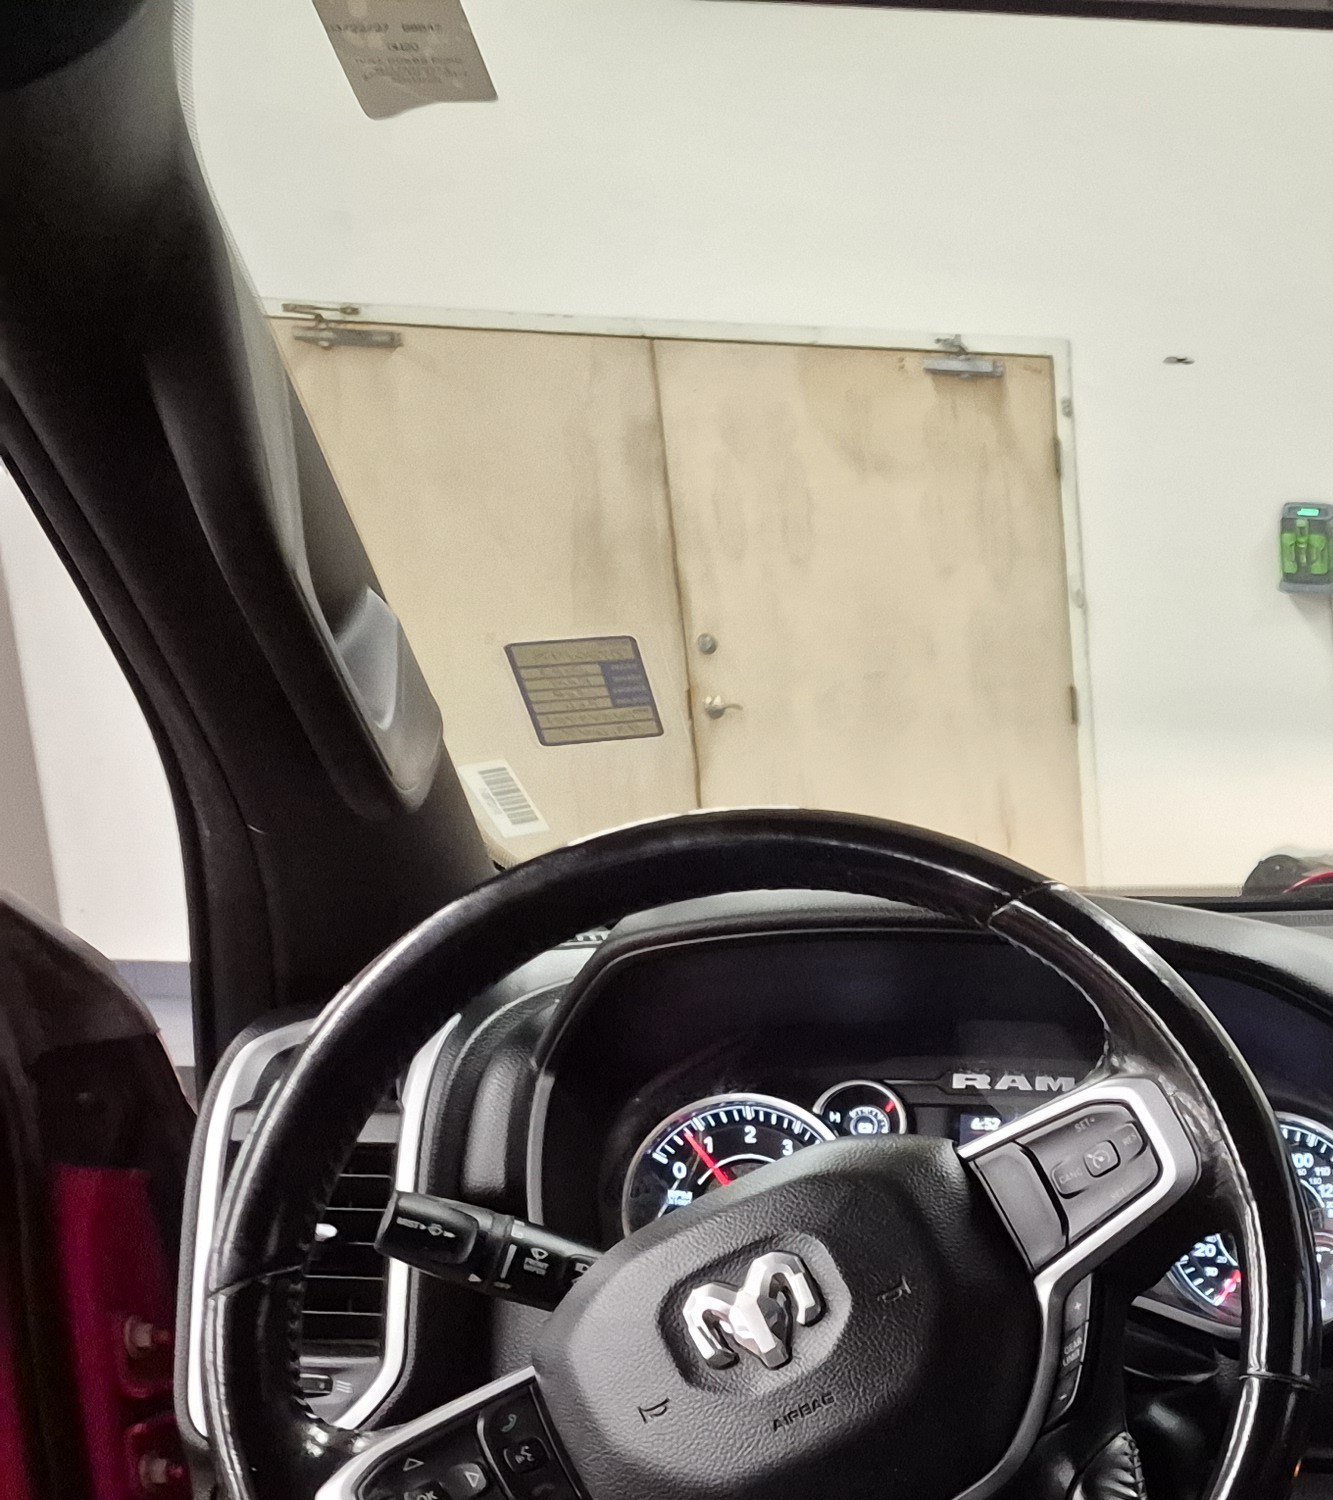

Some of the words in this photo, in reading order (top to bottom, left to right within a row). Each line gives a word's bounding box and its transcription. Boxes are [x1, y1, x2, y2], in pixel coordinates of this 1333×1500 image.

[952, 1073, 1076, 1092] RAM
[743, 1125, 758, 1144] 2
[704, 1136, 714, 1153] 1
[782, 1138, 793, 1157] 3
[1290, 1152, 1314, 1168] 00
[672, 1162, 687, 1179] 0
[1193, 1242, 1217, 1258] 20
